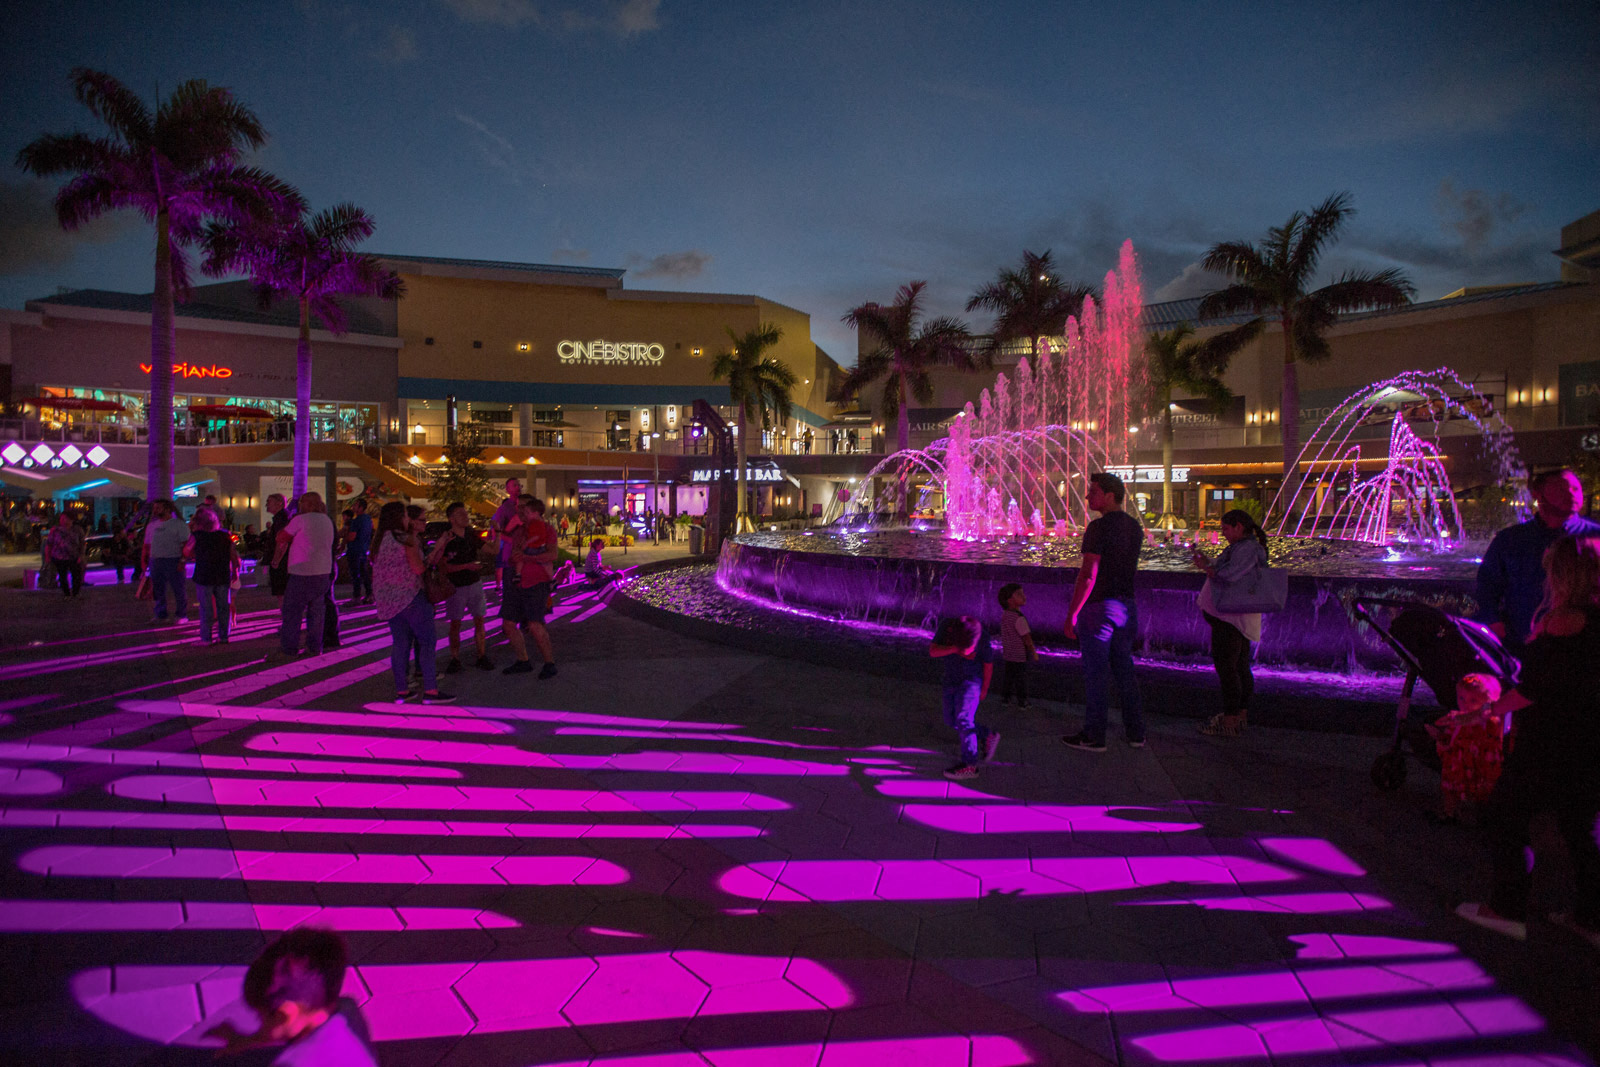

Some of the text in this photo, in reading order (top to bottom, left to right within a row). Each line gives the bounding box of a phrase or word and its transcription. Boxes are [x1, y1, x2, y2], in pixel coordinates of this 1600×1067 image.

[139, 362, 232, 378] VPIANO
[0, 456, 89, 470] OWL
[754, 469, 783, 481] BAR
